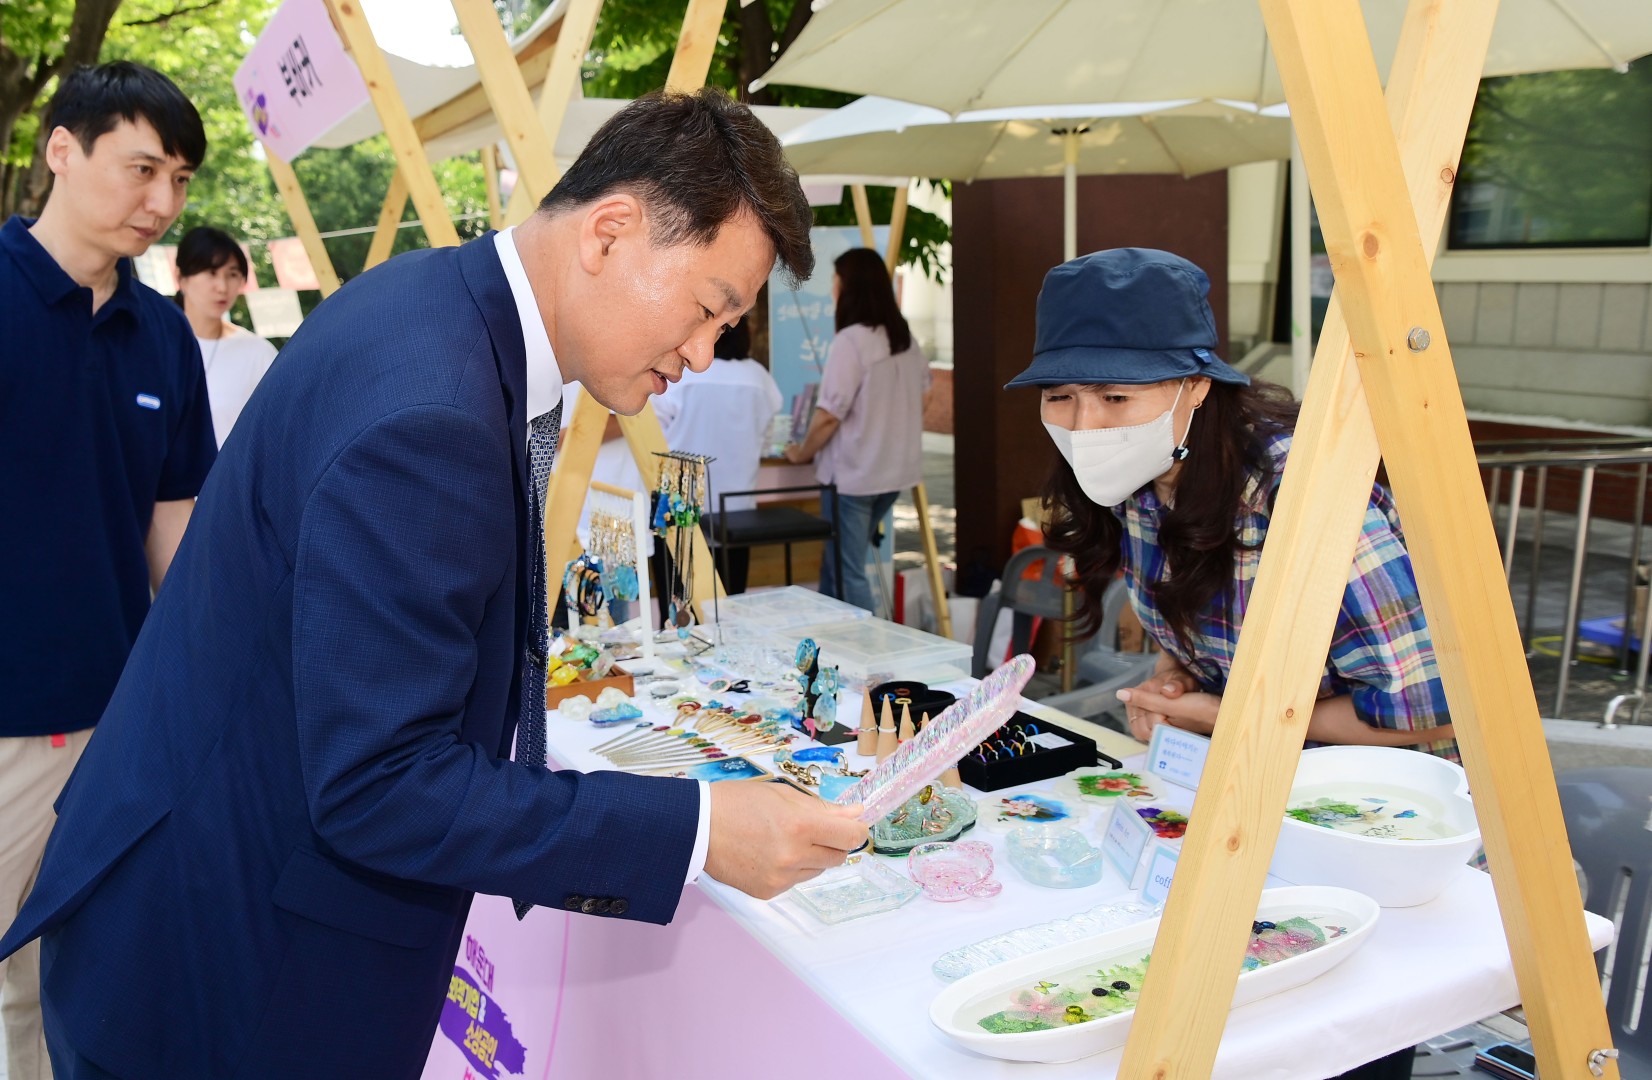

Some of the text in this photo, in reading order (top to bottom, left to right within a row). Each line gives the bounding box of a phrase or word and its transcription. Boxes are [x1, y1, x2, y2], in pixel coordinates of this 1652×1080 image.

[1155, 874, 1172, 889] coff
[466, 934, 495, 993] 해운대
[446, 974, 480, 1020] 회적기업
[463, 1020, 498, 1069] 소상공인
